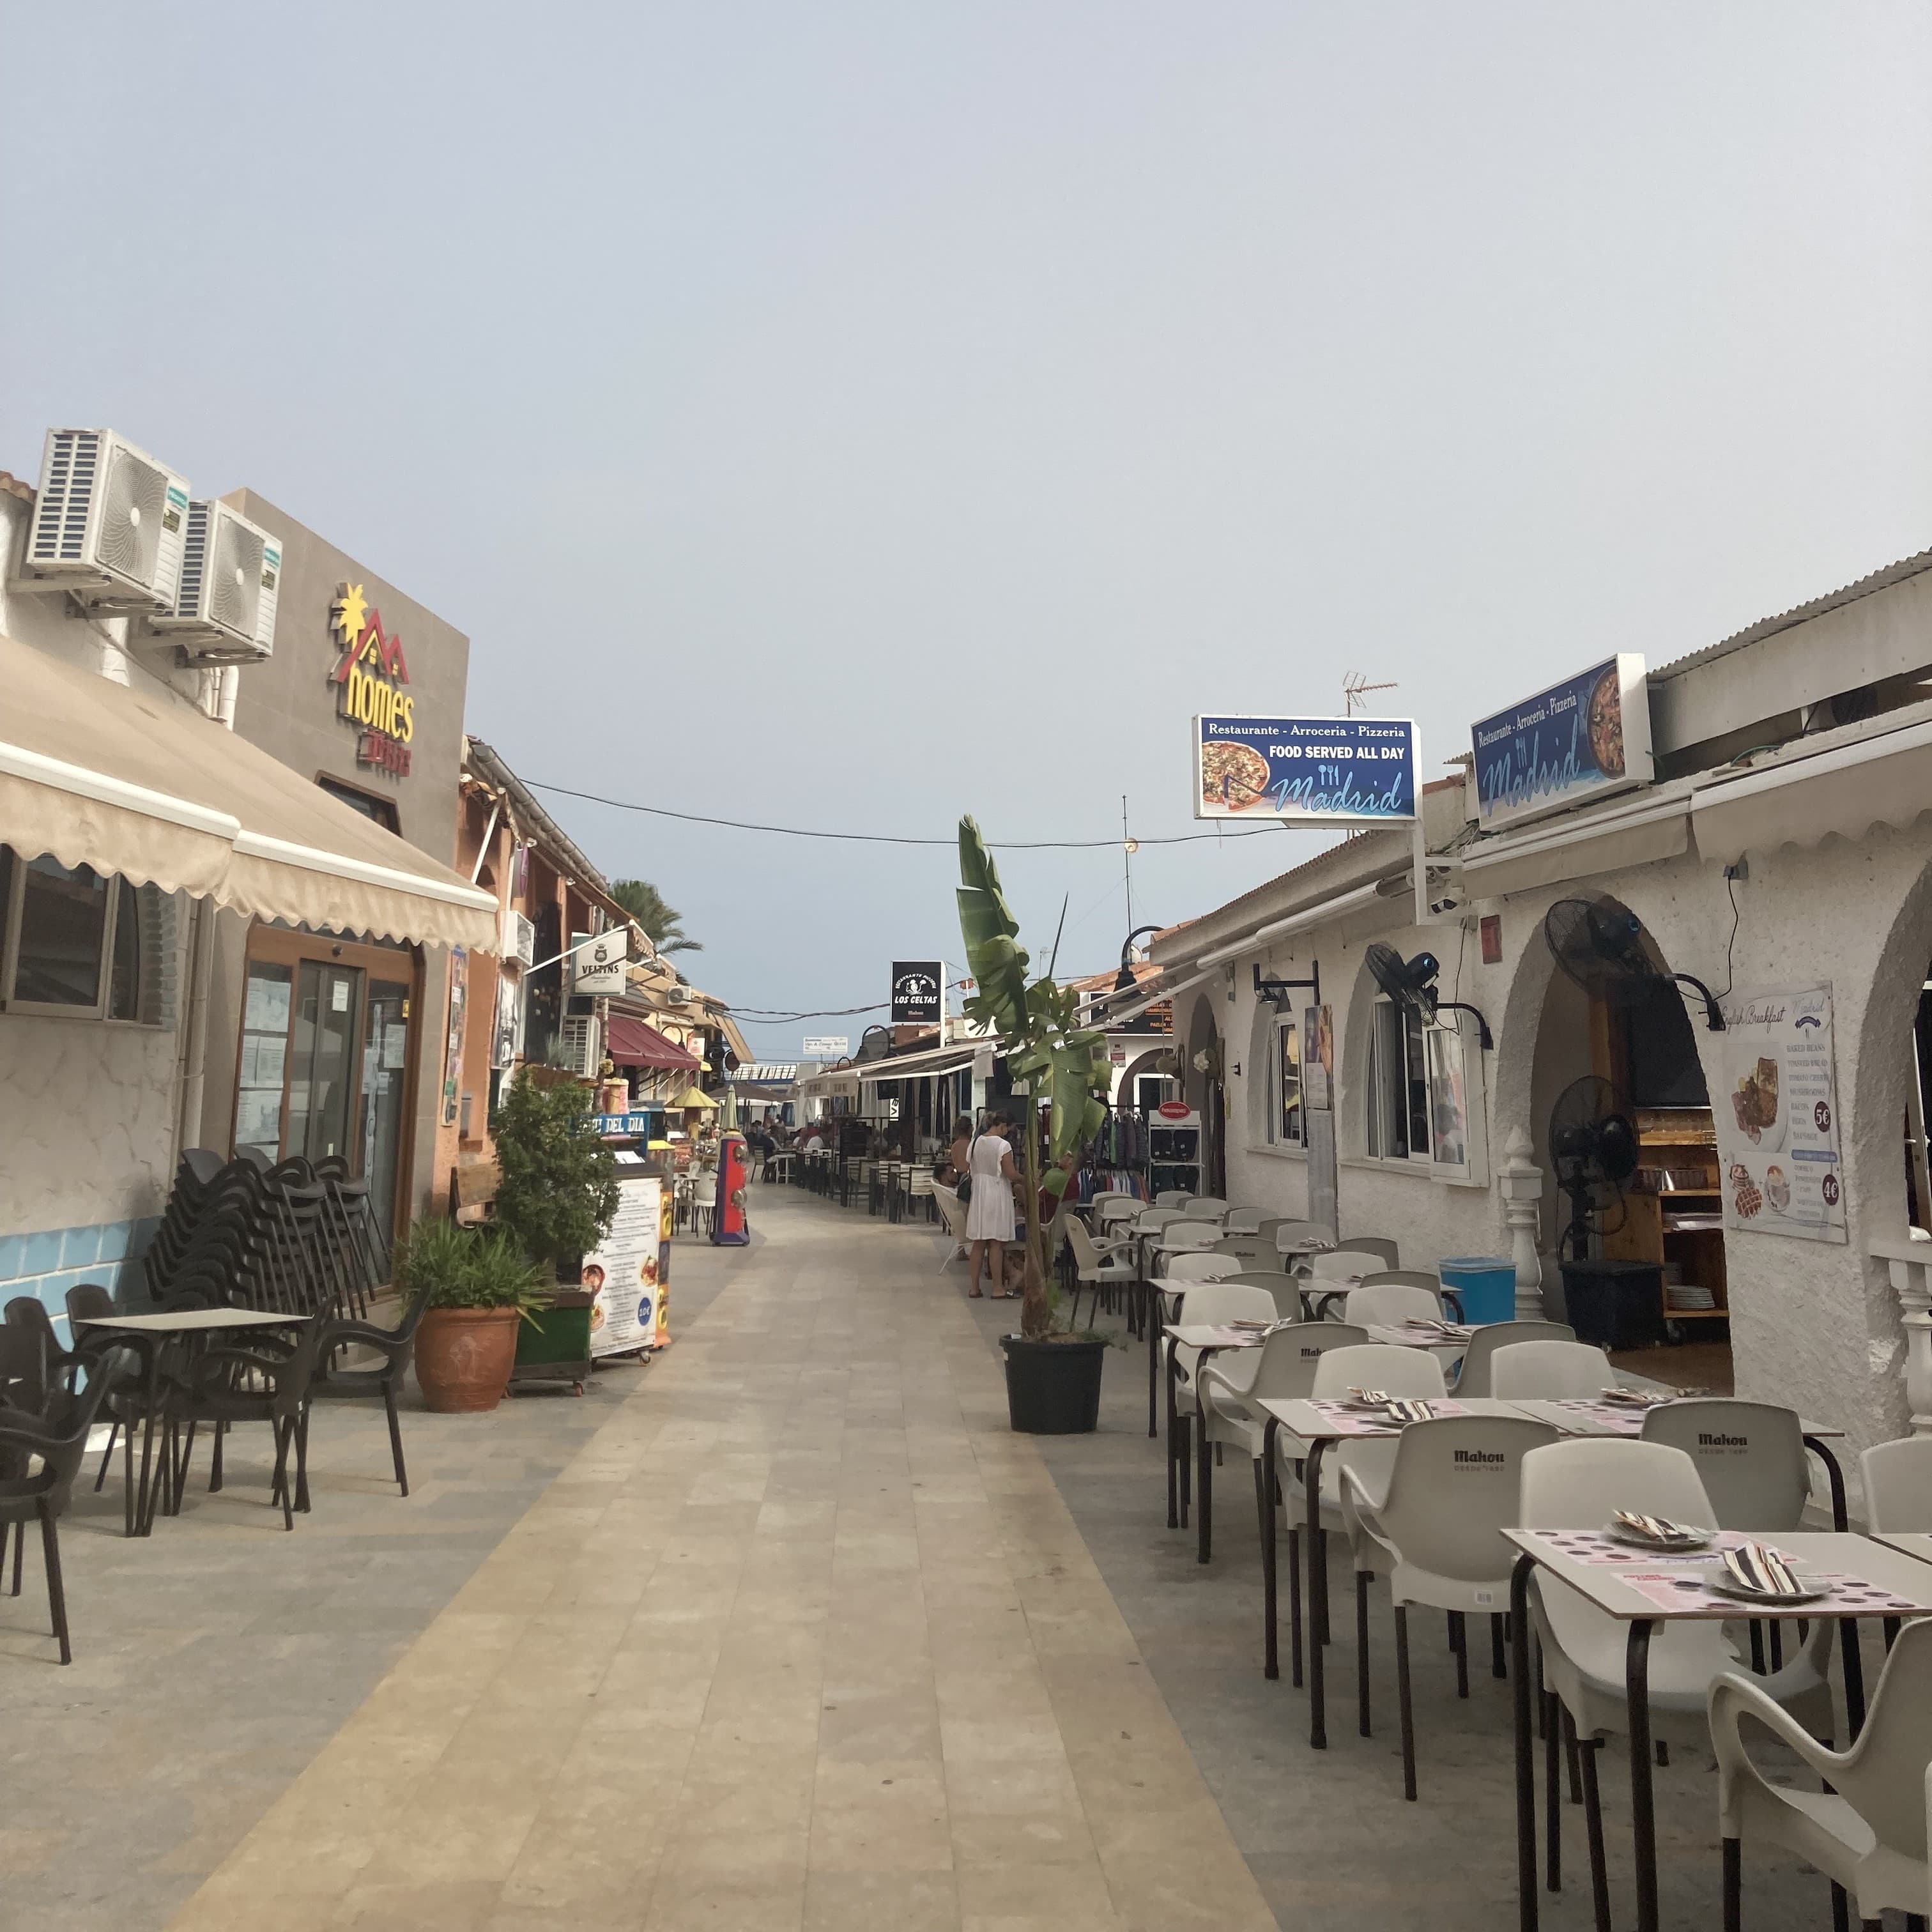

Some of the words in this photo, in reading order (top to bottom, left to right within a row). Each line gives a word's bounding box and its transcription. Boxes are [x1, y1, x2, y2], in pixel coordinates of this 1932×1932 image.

[348, 662, 414, 743] homes
[1478, 723, 1512, 748] Restaurante
[1517, 704, 1545, 732] Arroceria
[1550, 690, 1577, 716] Pizzeria
[1209, 723, 1279, 735] Restaurante
[1290, 724, 1347, 737] Arroceria
[1358, 726, 1405, 737] Pizzeria
[1269, 745, 1302, 758] FOOD
[1305, 746, 1353, 759] SERVED
[1356, 746, 1378, 759] ALL
[1381, 747, 1404, 760] DAY
[1483, 713, 1581, 817] Madrid
[1271, 771, 1402, 813] Madrid
[894, 995, 909, 1004] LOS
[910, 996, 937, 1004] CELTAS
[1745, 1004, 1786, 1034] Breakfast
[605, 1118, 624, 1133] DEL
[627, 1117, 645, 1132] DIA
[1816, 1109, 1830, 1125] 5€
[1823, 1182, 1838, 1198] 4€
[639, 1306, 650, 1317] 10€
[1698, 1434, 1747, 1446] Mahou
[1454, 1450, 1505, 1462] Mahou
